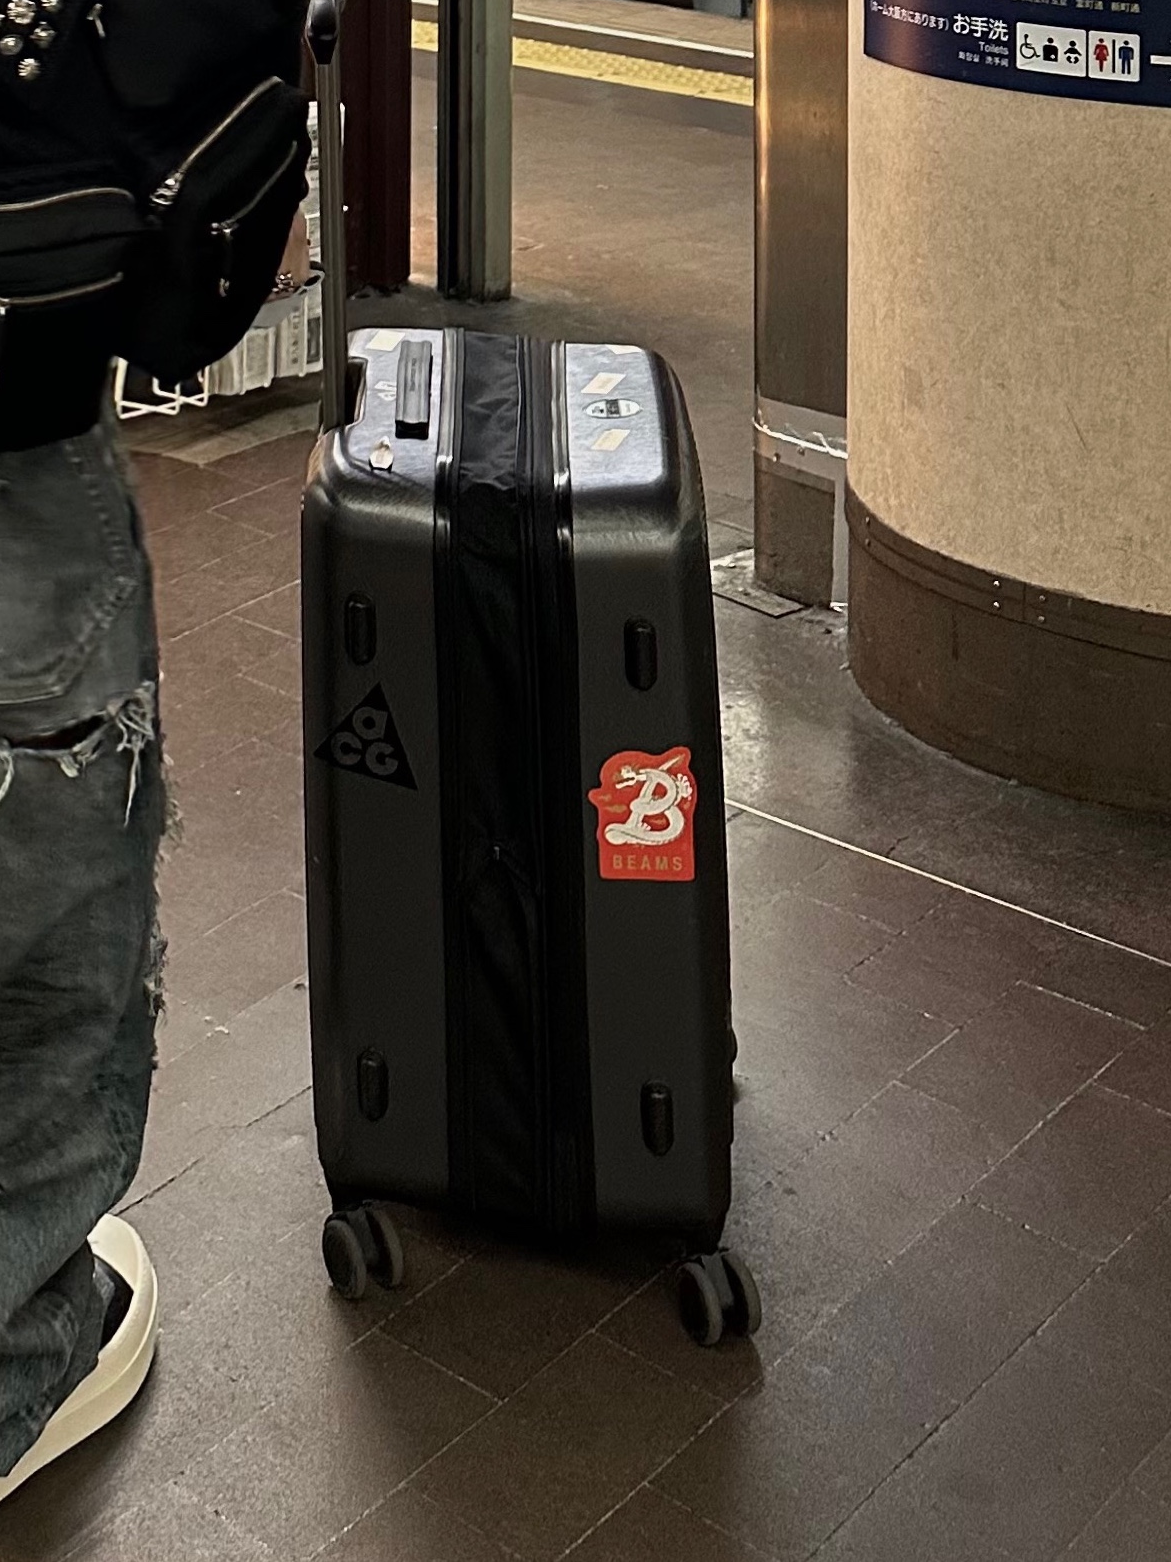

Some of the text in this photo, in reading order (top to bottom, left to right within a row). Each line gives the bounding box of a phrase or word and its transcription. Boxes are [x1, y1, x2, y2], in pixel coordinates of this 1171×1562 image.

[953, 13, 1009, 42] お手洗
[978, 41, 1009, 55] Toilets
[612, 854, 684, 872] BEAMS
